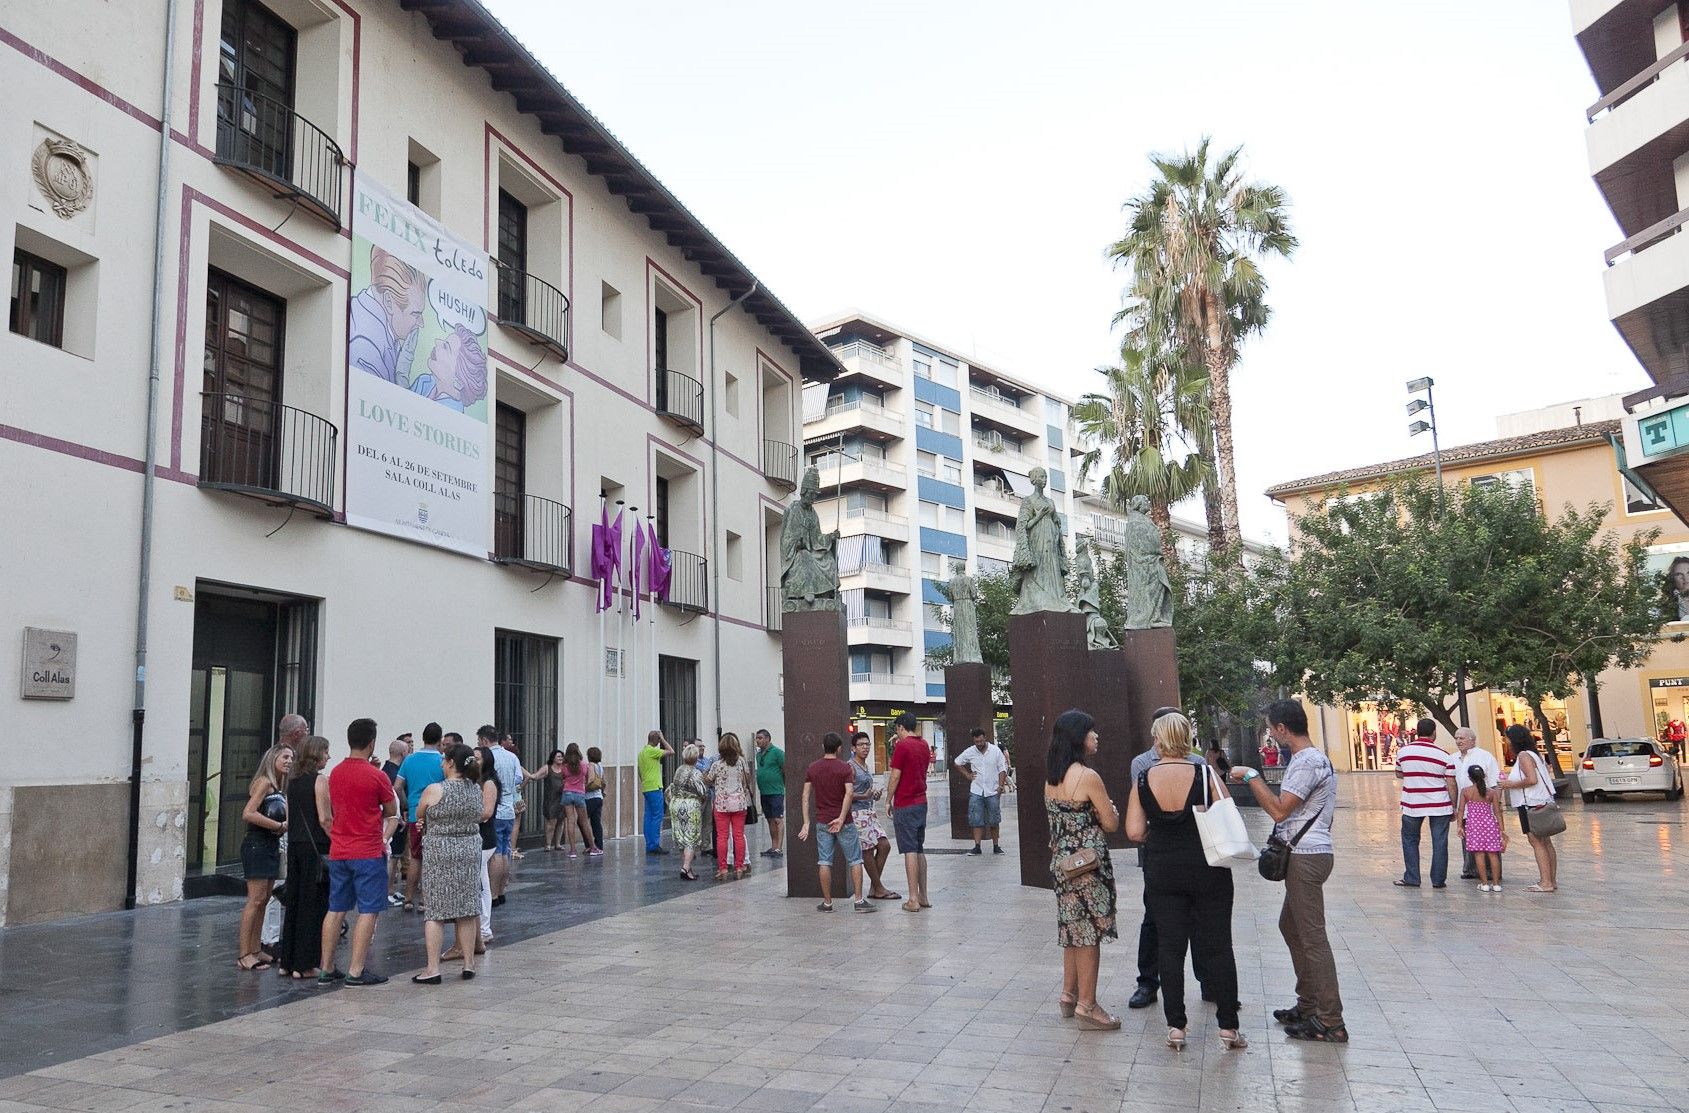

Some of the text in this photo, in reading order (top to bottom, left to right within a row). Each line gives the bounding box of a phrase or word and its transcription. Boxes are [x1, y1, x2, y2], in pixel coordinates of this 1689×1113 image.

[438, 289, 476, 322] HUSH!!
[359, 399, 480, 460] LOVE STORIES
[1645, 421, 1667, 445] T
[357, 444, 478, 493] DEL 6 AL 26 DE SETEMBRE
[385, 470, 461, 501] SALA COLL ALAS
[33, 671, 70, 684] Coll Alas
